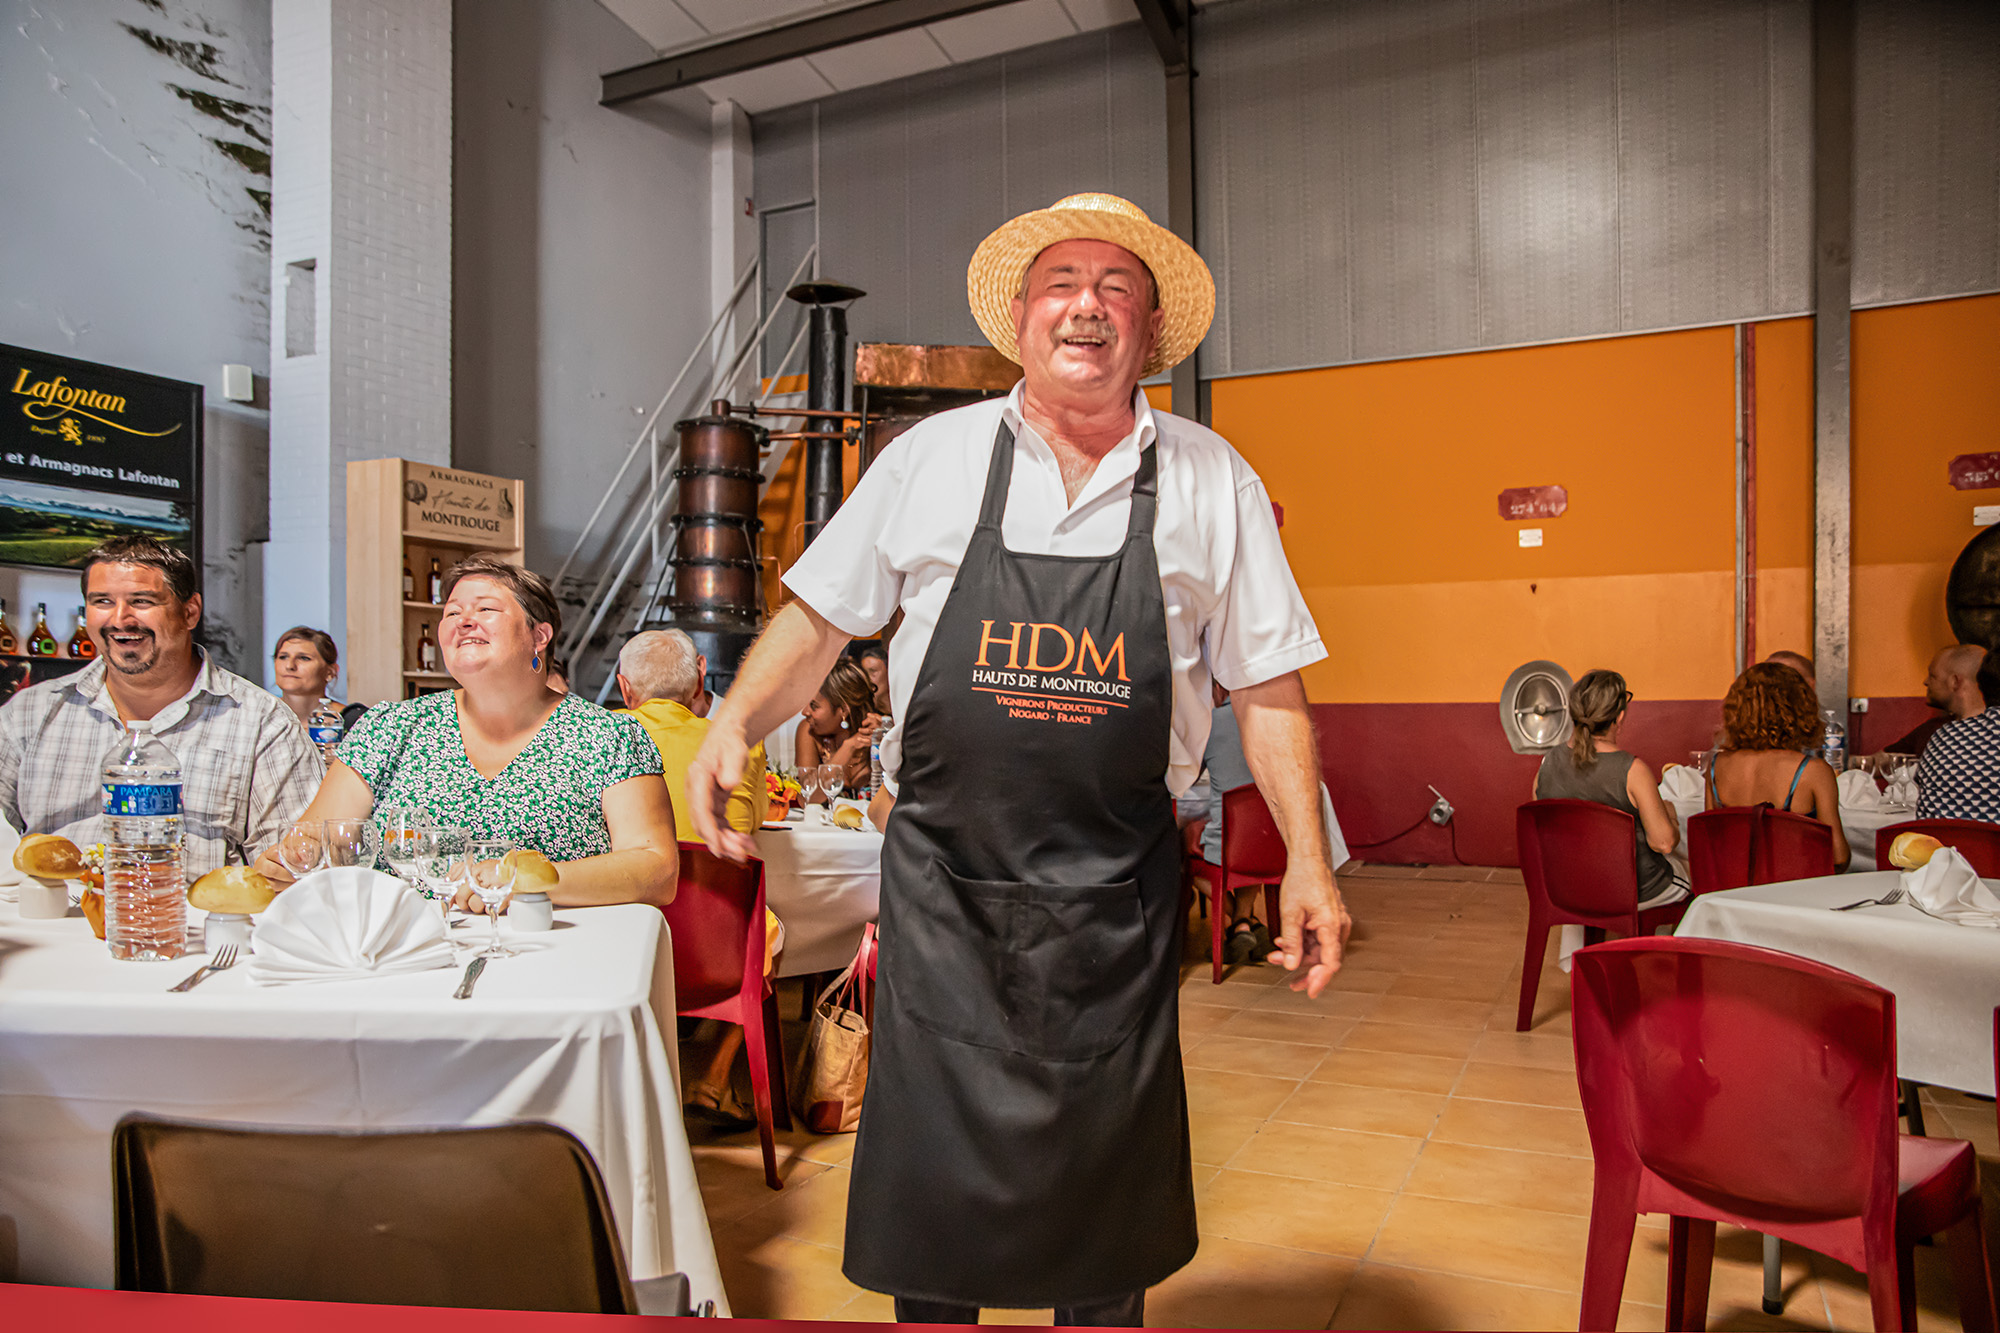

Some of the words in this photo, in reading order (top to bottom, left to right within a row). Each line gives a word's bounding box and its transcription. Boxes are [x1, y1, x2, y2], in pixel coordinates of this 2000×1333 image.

[11, 368, 127, 413] Lafontan
[5, 453, 25, 465] et
[29, 454, 114, 478] Armagnacs
[118, 467, 180, 489] Lafontan
[429, 470, 494, 489] ARMAGNACS
[421, 510, 500, 532] MONTROUGE
[974, 619, 1131, 682] HDM
[972, 669, 1016, 687] HAUTS
[1018, 673, 1037, 688] DE
[1041, 676, 1131, 699] MONTROUGE
[120, 786, 173, 797] PAMPARA
